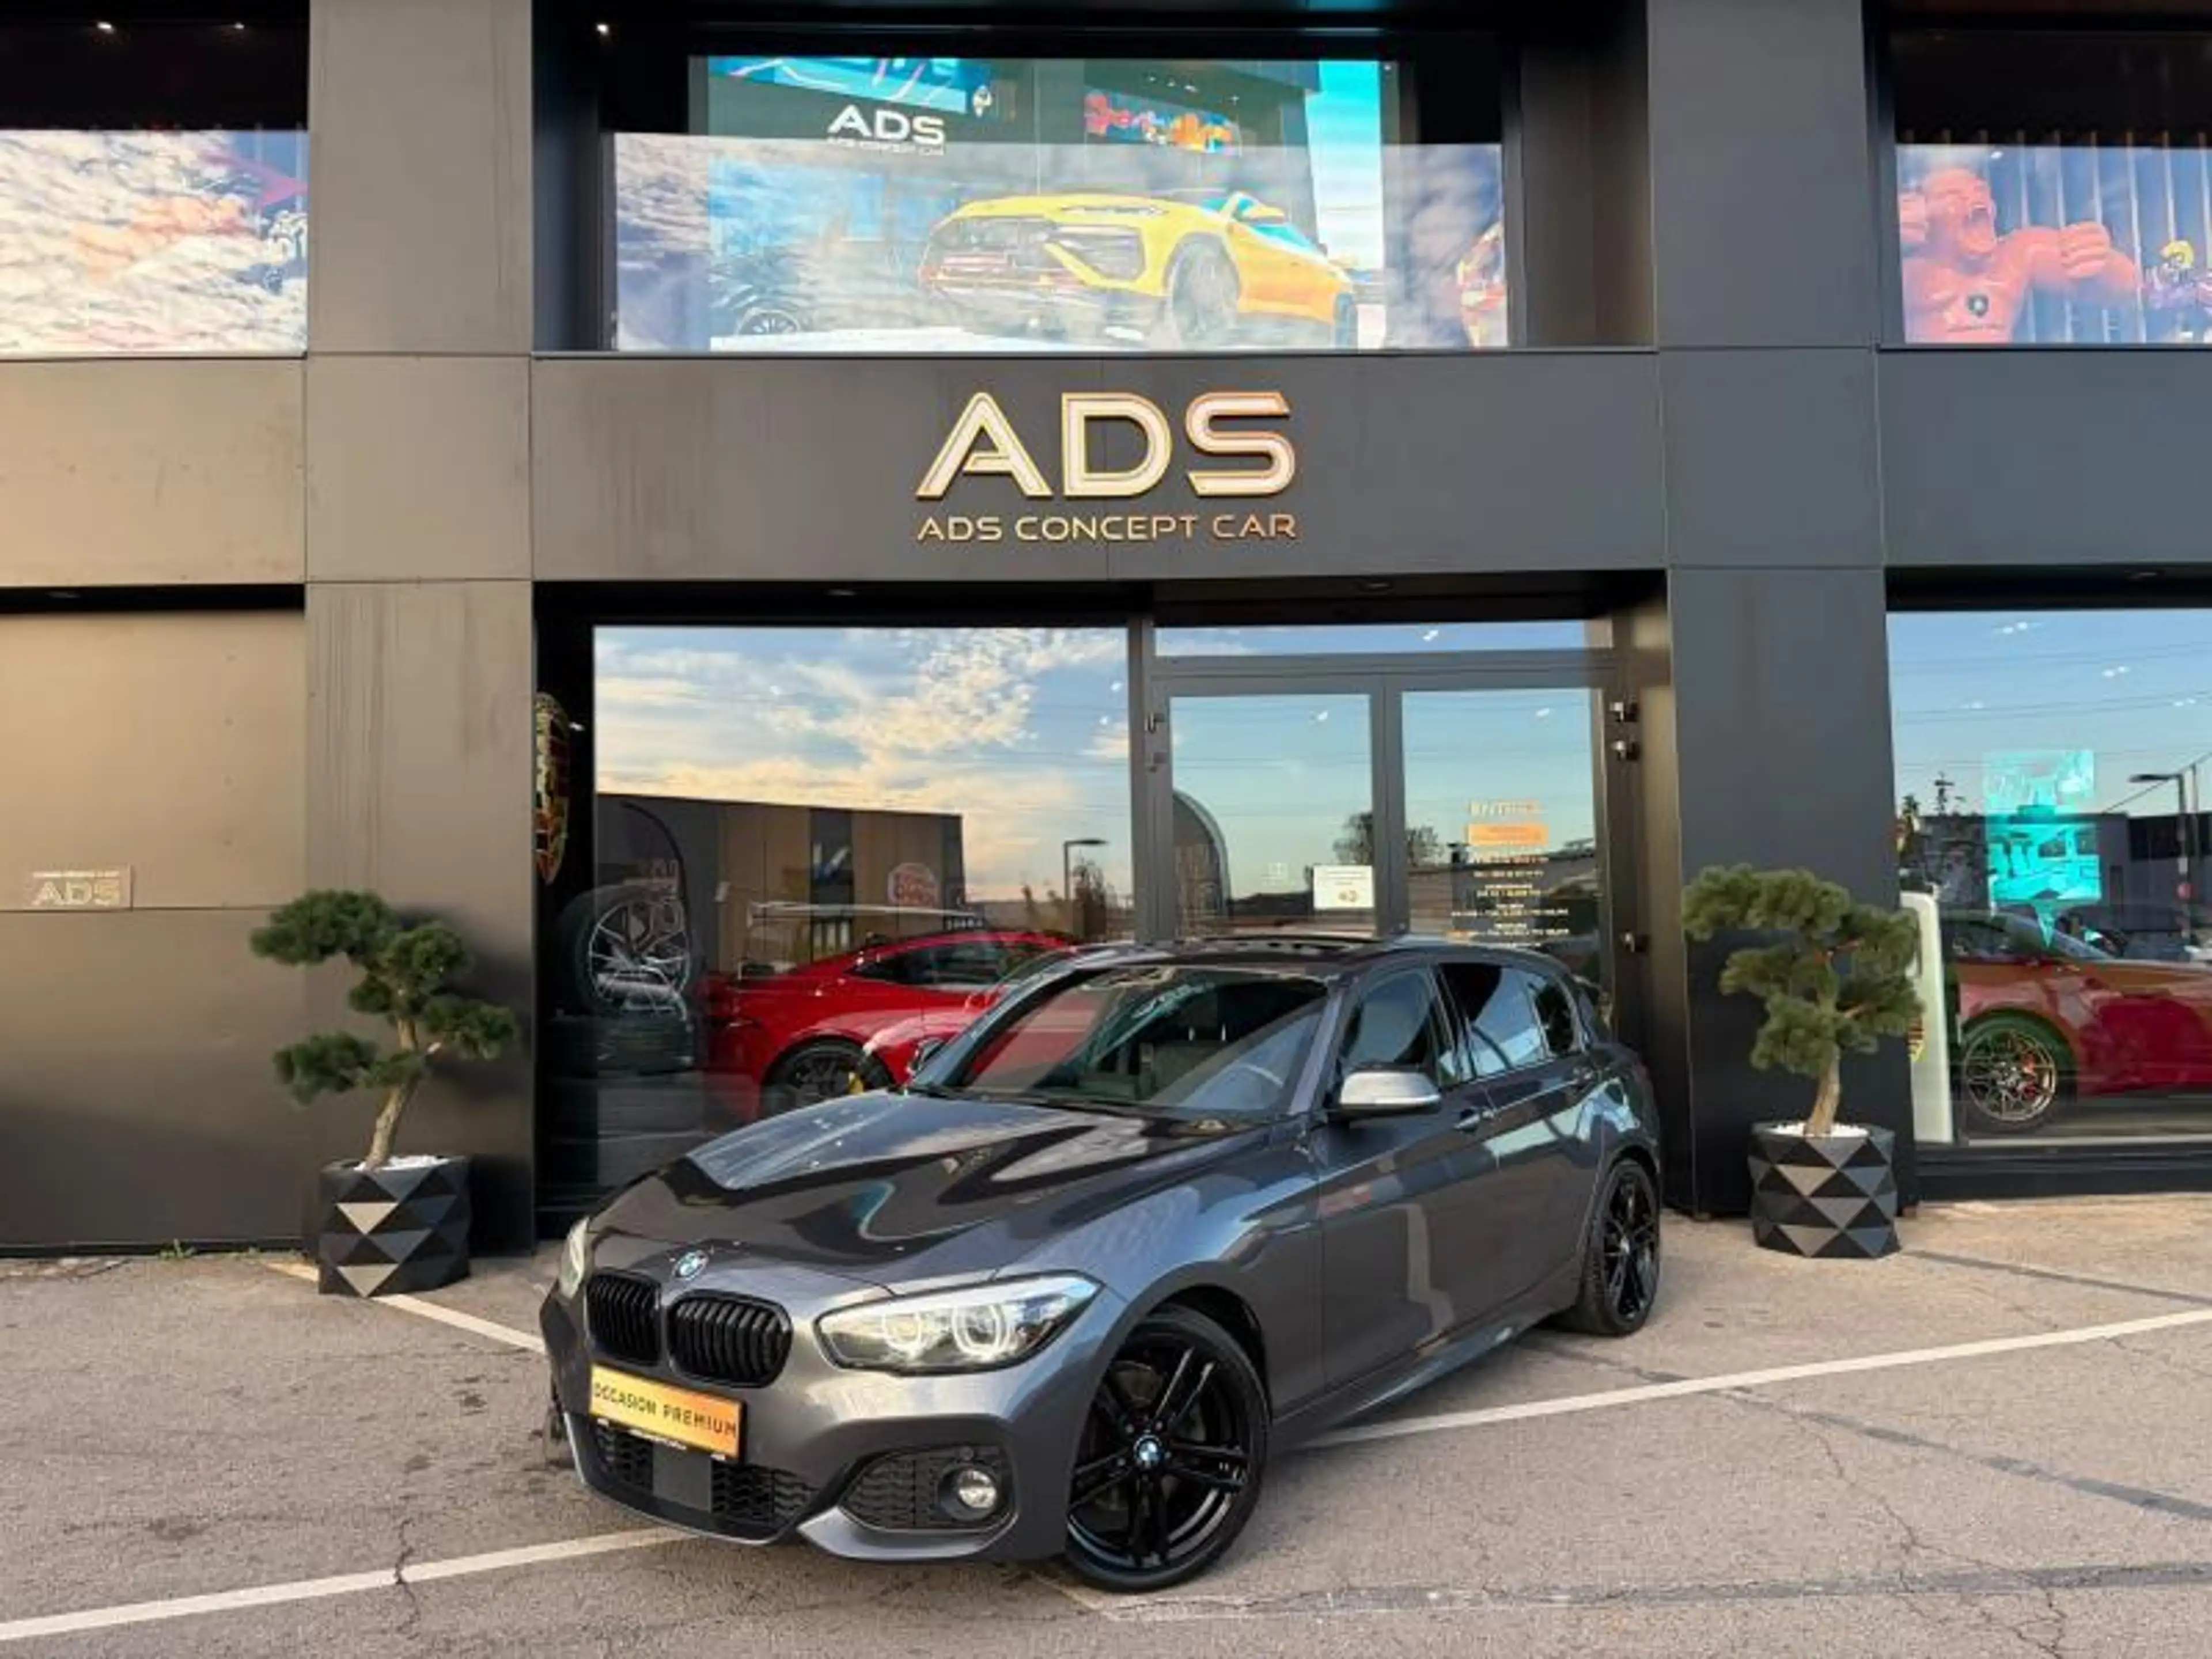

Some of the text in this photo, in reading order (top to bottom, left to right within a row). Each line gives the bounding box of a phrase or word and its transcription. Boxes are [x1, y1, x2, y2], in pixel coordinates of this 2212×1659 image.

[827, 104, 945, 145] ADS
[916, 392, 1296, 498] ADS
[918, 513, 1297, 542] ADS CONCEPT CAR
[31, 881, 120, 906] ADS
[594, 1382, 736, 1438] OCCASION PREMIUM
